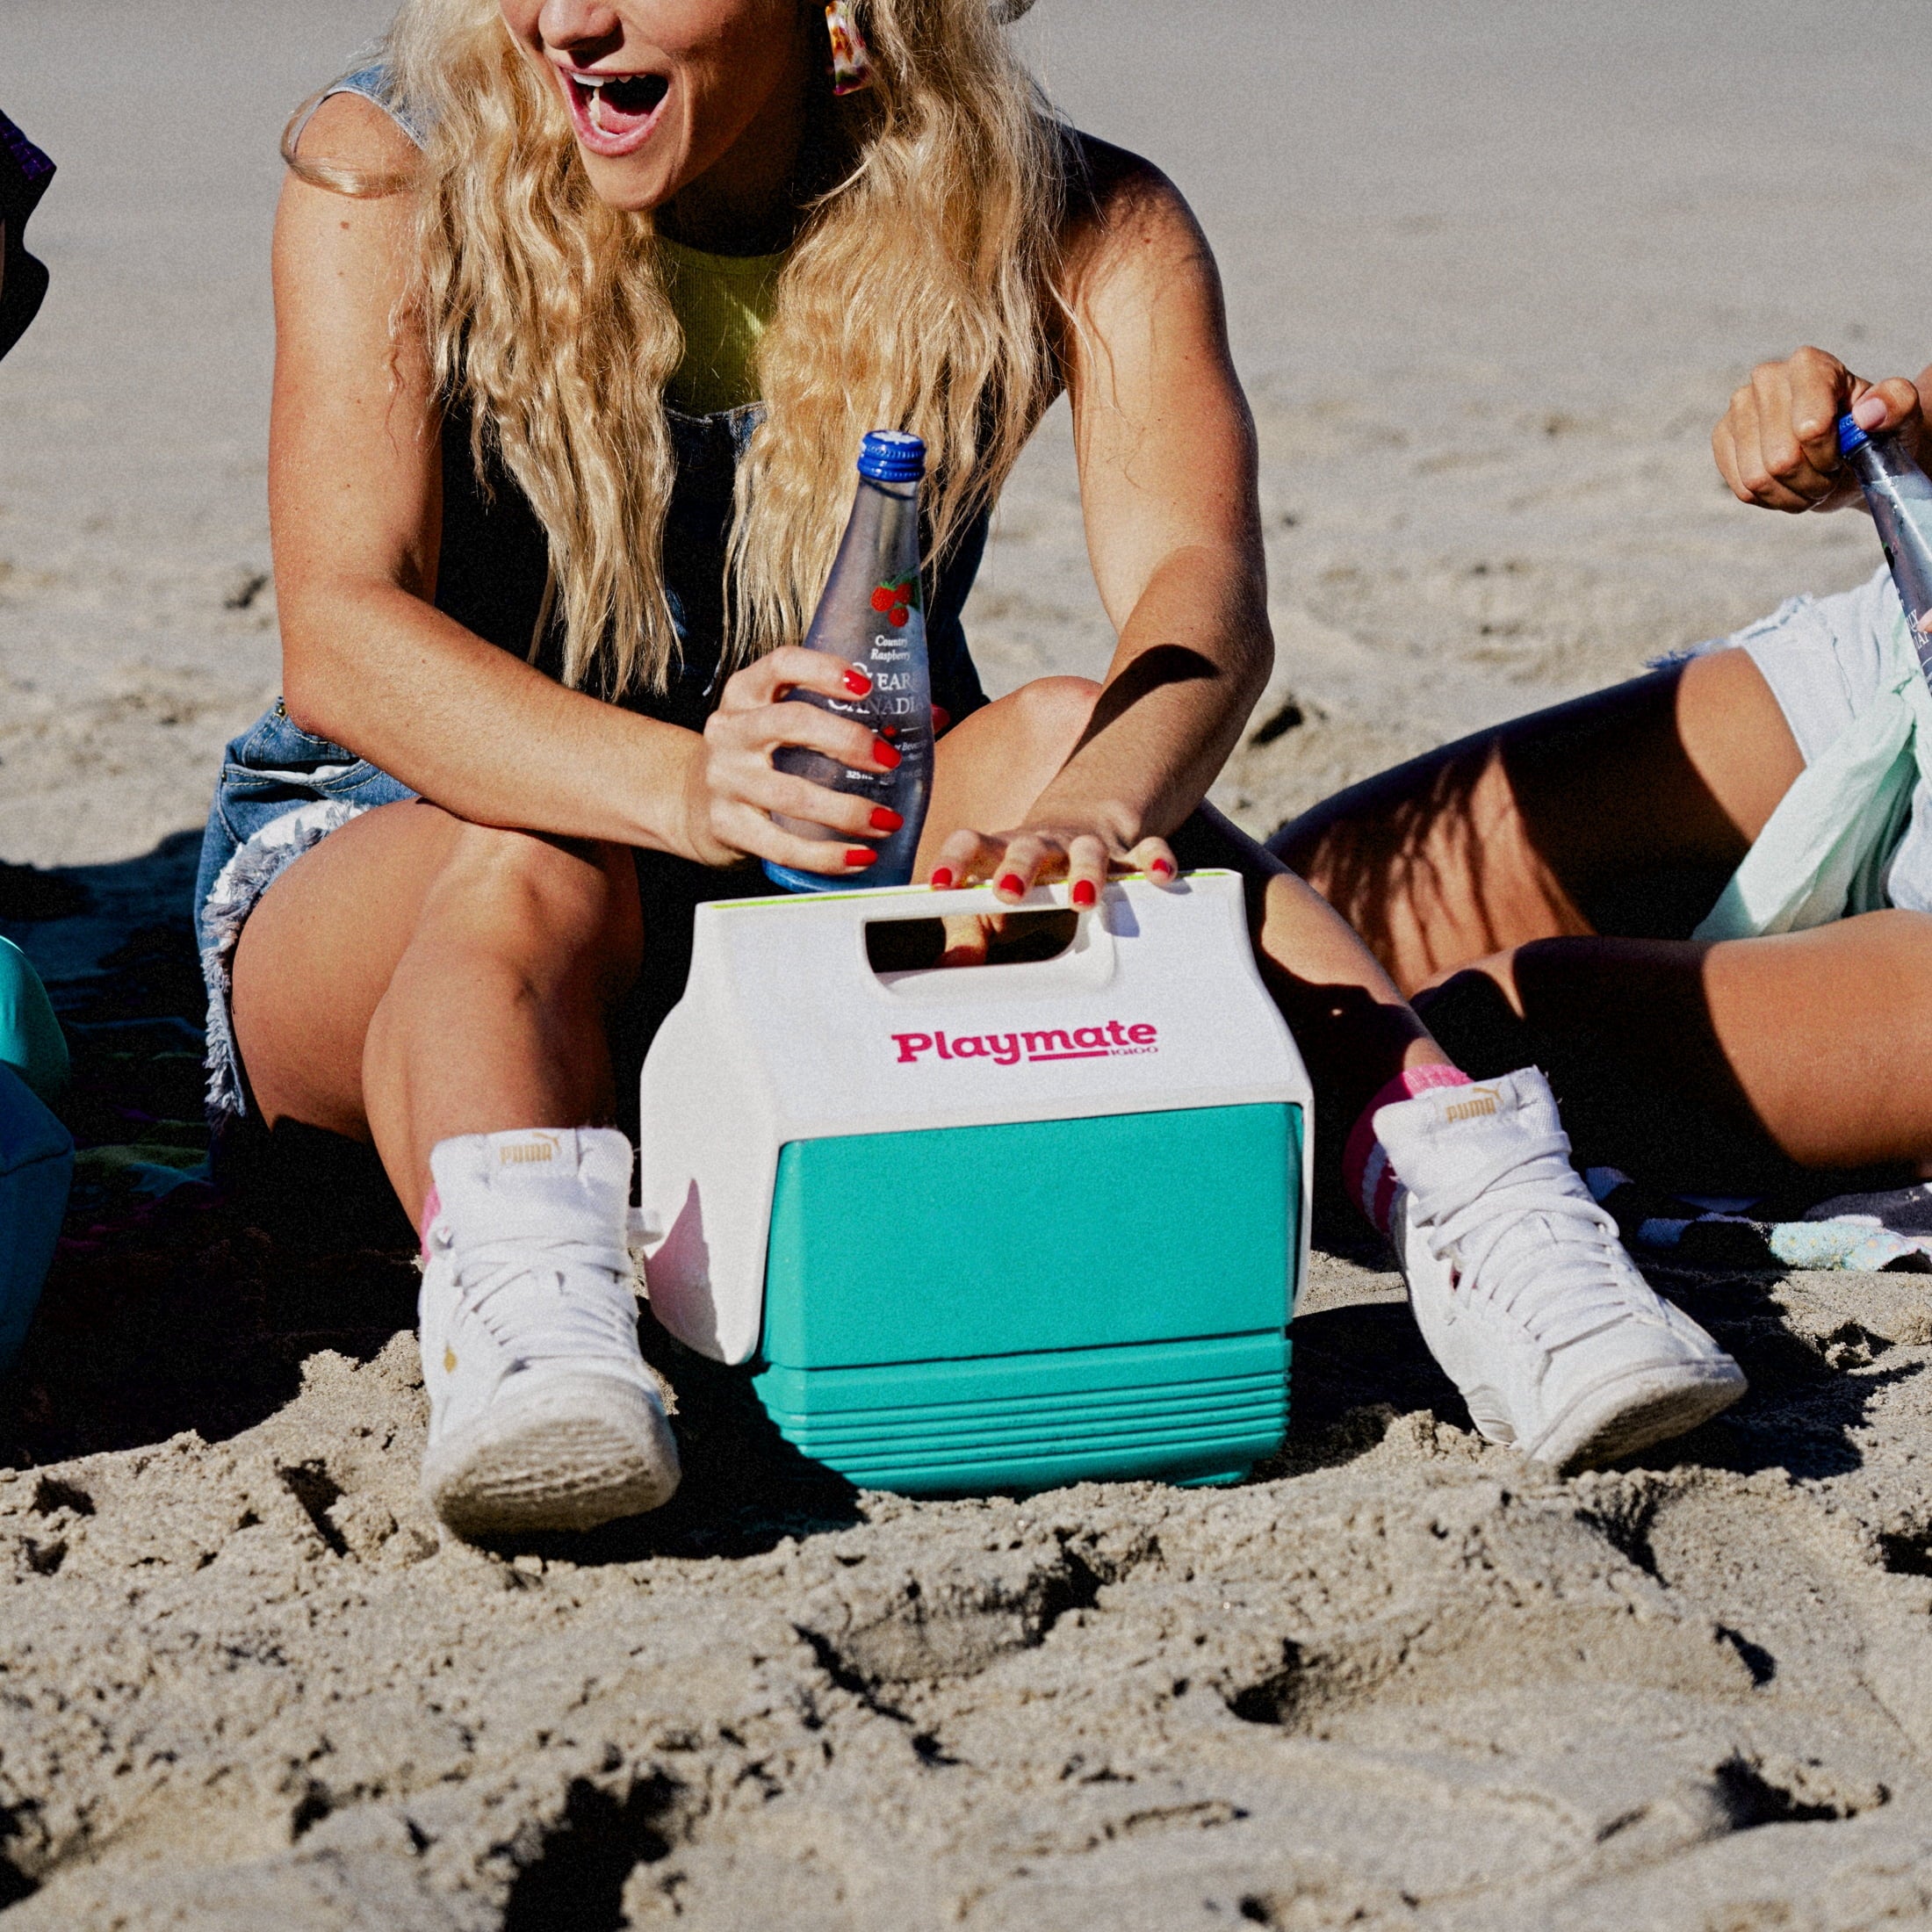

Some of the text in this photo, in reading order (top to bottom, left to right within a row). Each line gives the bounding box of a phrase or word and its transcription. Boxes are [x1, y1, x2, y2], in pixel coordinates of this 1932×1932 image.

[875, 635, 908, 648] Country
[870, 648, 911, 662] Raspberry
[891, 1020, 1158, 1065] Playmate
[1446, 1096, 1497, 1124] PUMA
[500, 1143, 552, 1166] PUMA
